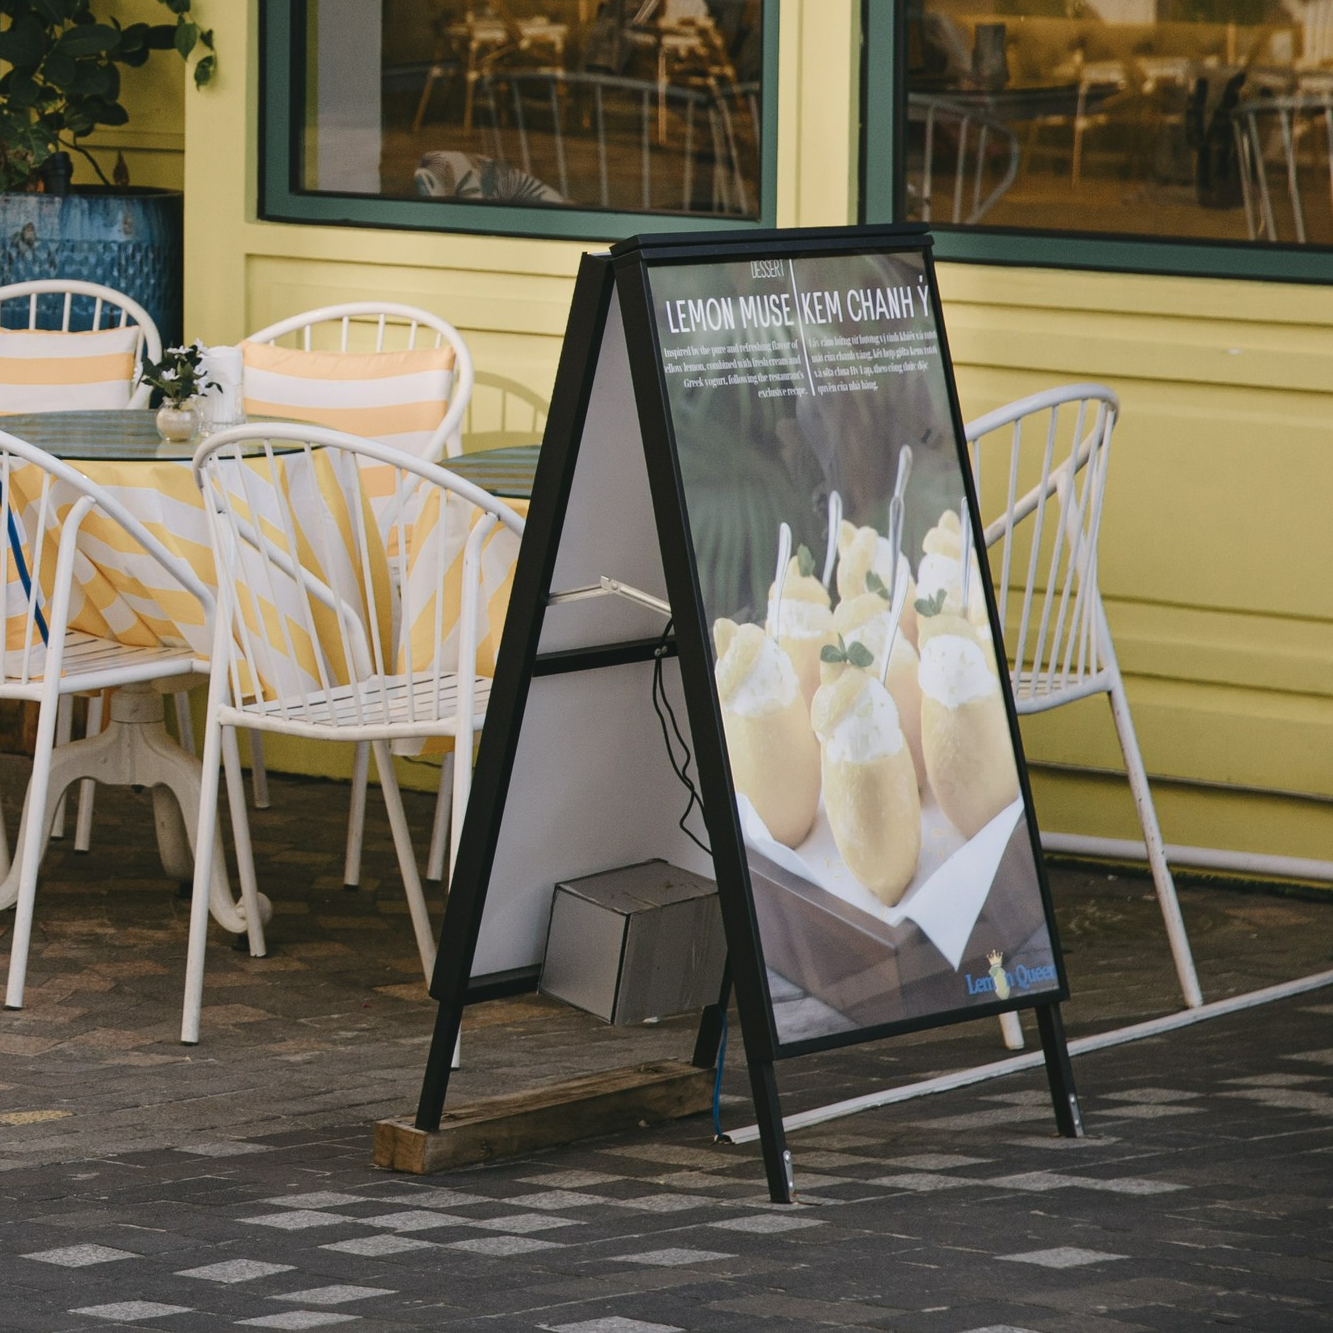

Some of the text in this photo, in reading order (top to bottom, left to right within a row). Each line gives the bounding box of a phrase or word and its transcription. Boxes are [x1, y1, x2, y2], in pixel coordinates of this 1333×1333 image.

[750, 259, 785, 278] DESSERT
[665, 293, 794, 334] LEMON MUSE
[801, 290, 843, 325] KEM
[846, 285, 915, 323] CHANH
[701, 345, 711, 355] the
[727, 343, 739, 353] and
[791, 339, 798, 349] of
[737, 358, 752, 368] with
[752, 357, 768, 367] fresh
[768, 357, 789, 366] cream
[789, 355, 801, 365] and
[683, 377, 704, 388] Greek
[758, 373, 768, 383] the
